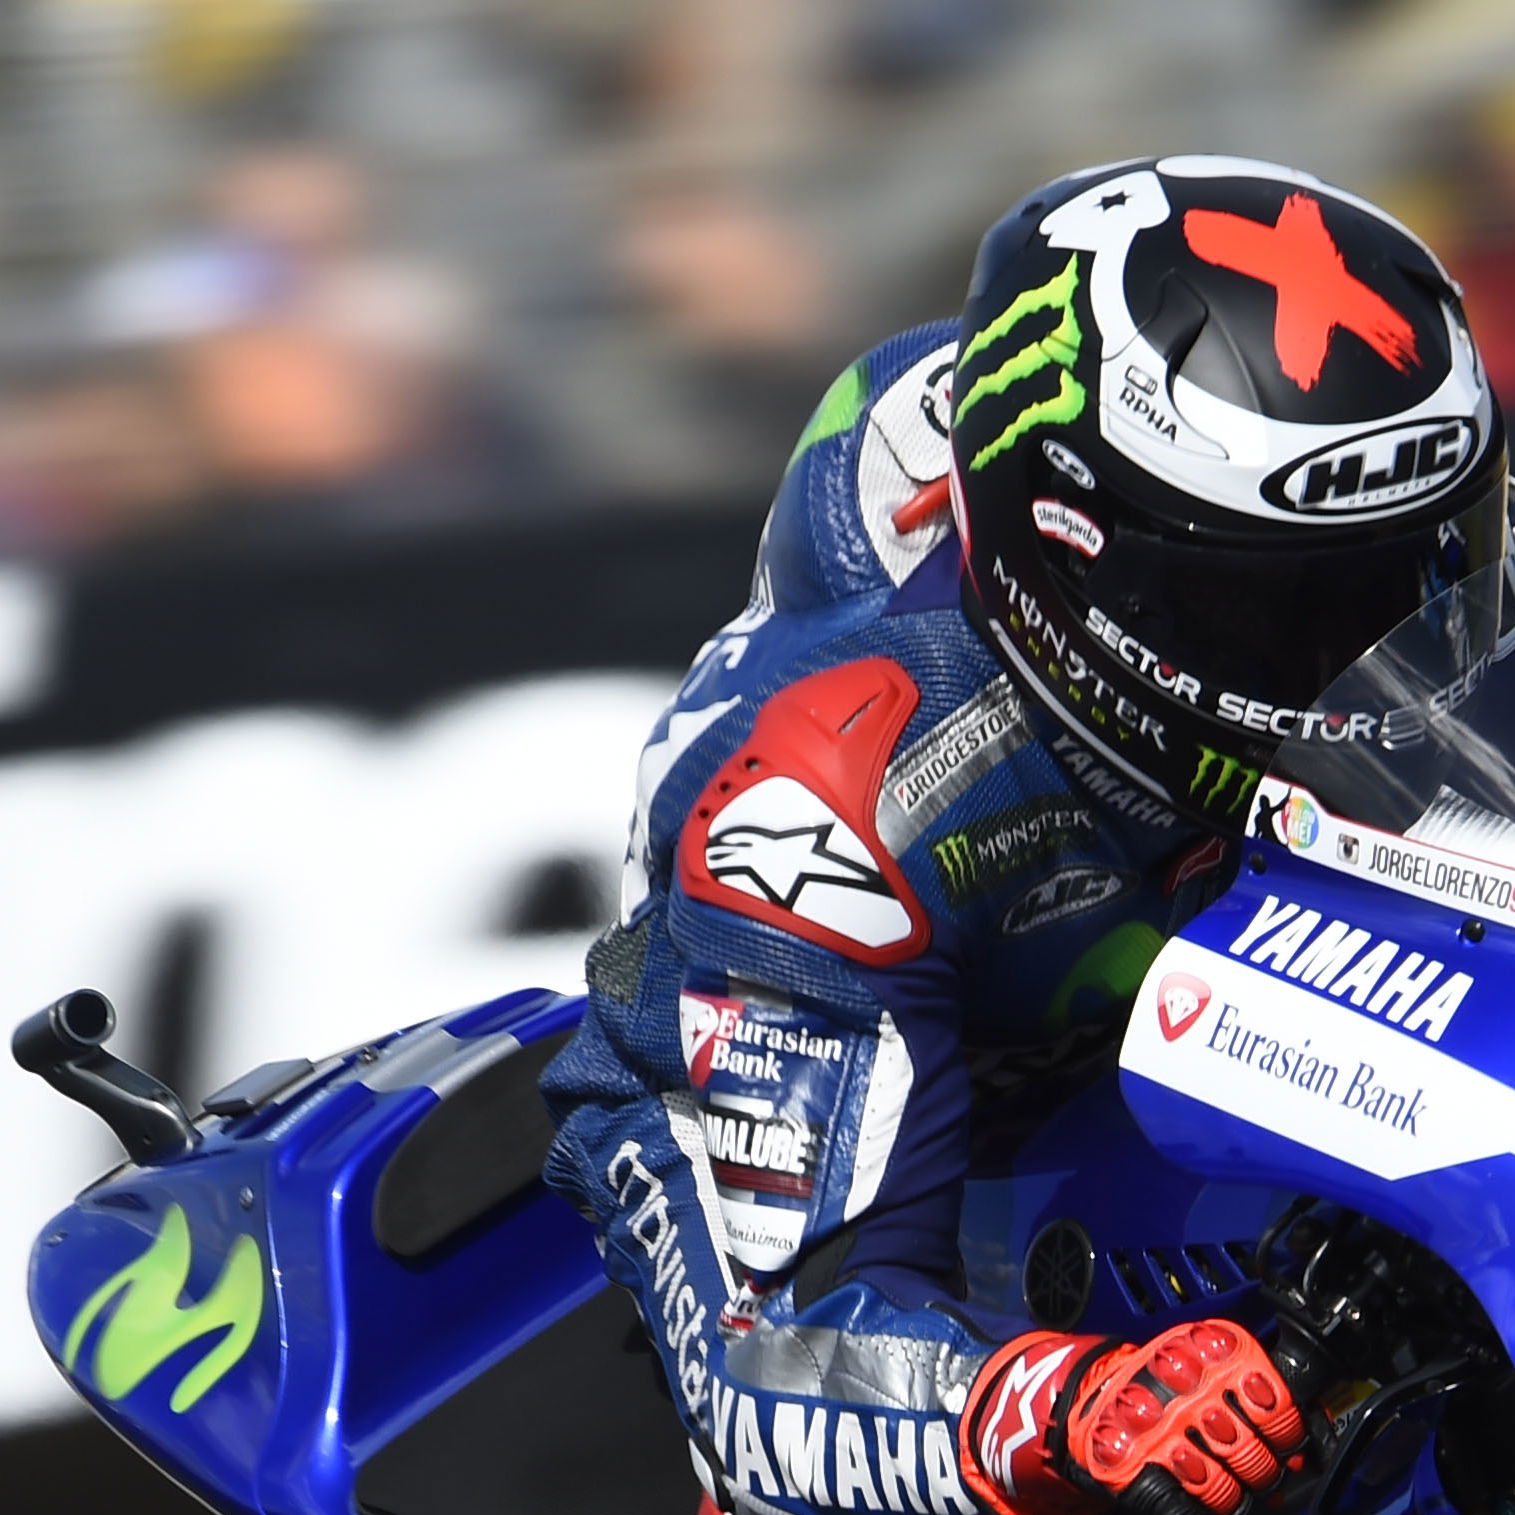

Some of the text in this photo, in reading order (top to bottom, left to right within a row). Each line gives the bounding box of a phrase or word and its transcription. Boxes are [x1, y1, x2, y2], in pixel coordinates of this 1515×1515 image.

[1120, 387, 1176, 444] RPHA
[1299, 421, 1462, 507] HJC
[993, 556, 1166, 752] MONSTER
[1085, 605, 1202, 706] SECTOR
[1428, 650, 1494, 723] SECT
[1215, 691, 1377, 743] SECTOR
[1052, 733, 1177, 829] YAMAHA
[976, 808, 1094, 862] MONSTER
[1226, 895, 1475, 1042] YAMAHA
[709, 1038, 784, 1083] Bank
[717, 1006, 843, 1062] Eurasian
[1206, 1002, 1427, 1136] Eurasian Bank
[704, 1111, 808, 1175] MALUBE
[607, 1139, 712, 1416] movista
